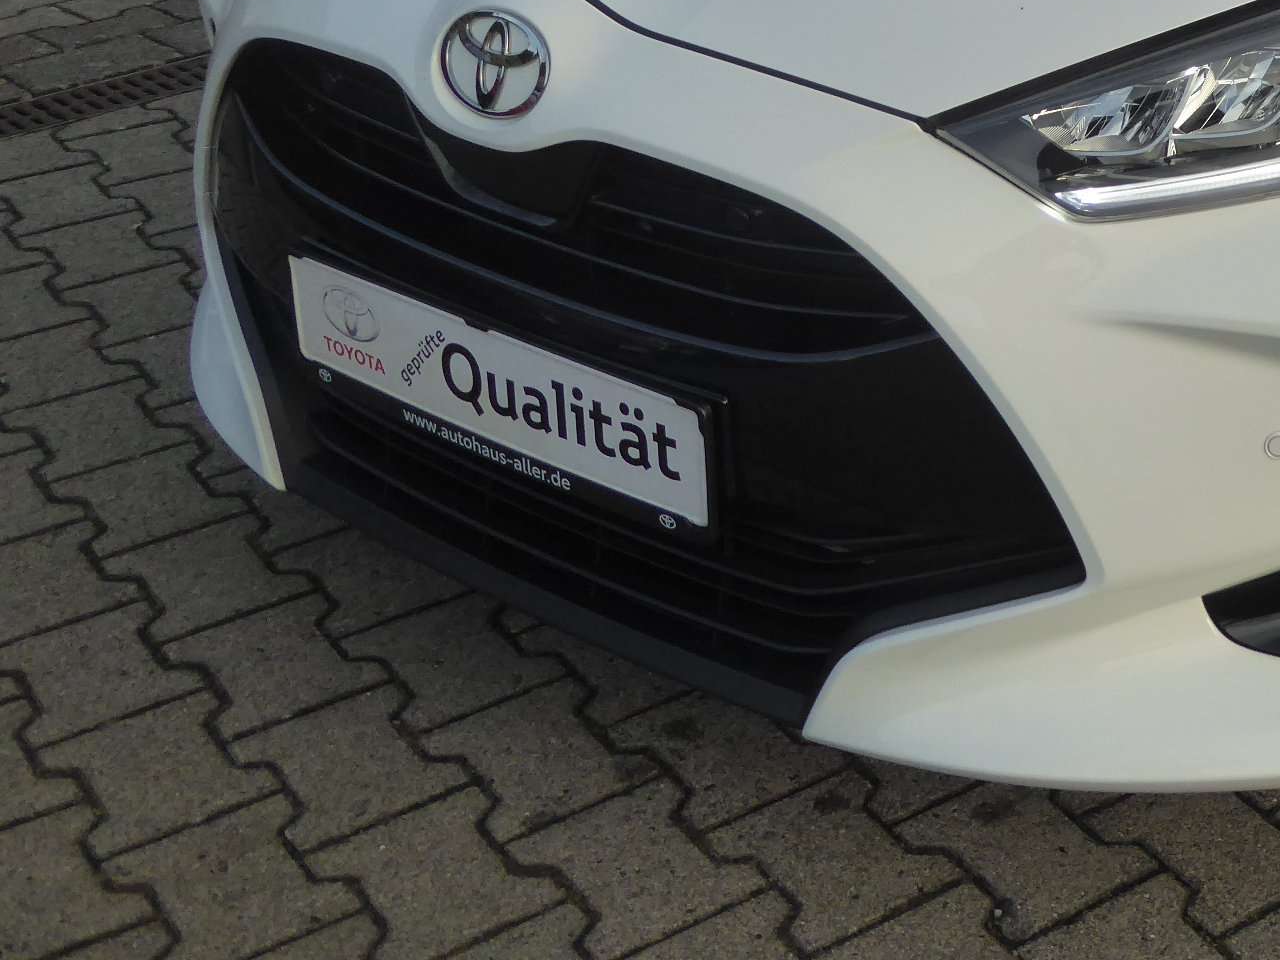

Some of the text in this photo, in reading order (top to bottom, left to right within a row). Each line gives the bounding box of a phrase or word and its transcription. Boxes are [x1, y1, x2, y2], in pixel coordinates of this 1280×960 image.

[322, 335, 386, 375] TOYOTA
[401, 328, 446, 386] geprüfte
[441, 342, 681, 482] Qualität
[402, 408, 572, 491] www.autohaus-aller.de
